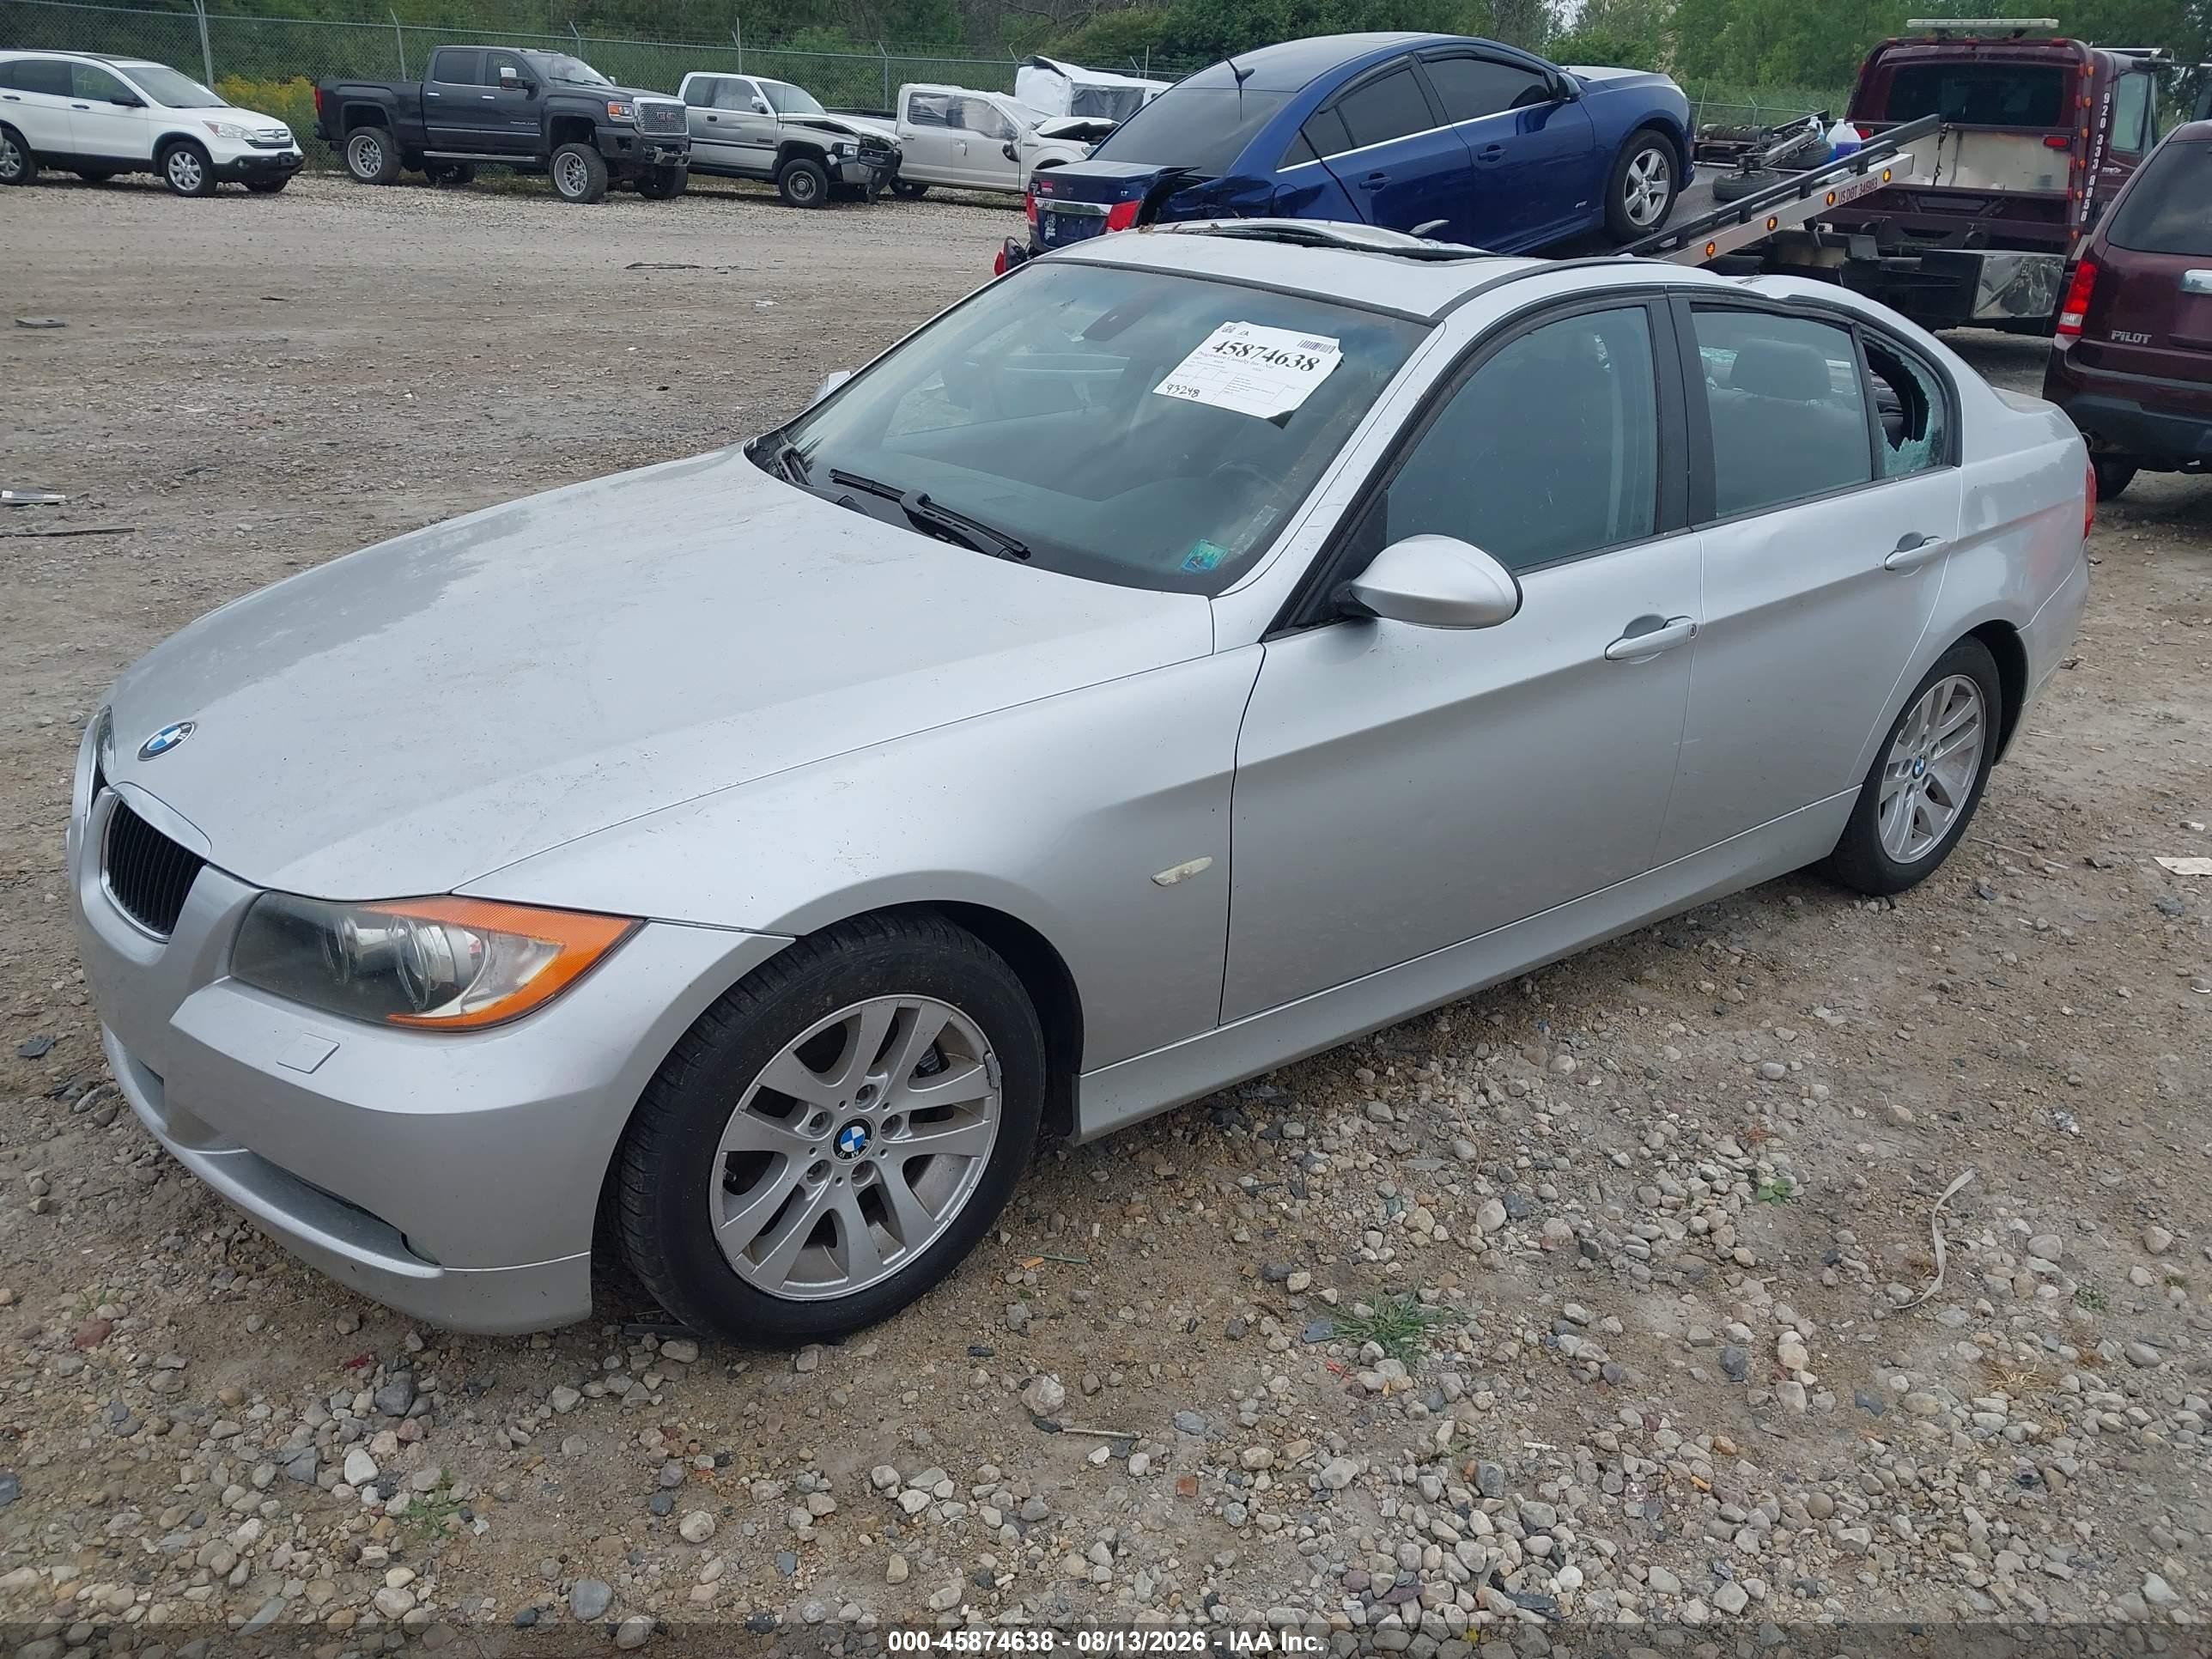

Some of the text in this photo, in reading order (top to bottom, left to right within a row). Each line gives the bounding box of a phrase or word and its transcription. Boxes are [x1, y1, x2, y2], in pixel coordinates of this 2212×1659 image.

[2100, 93, 2110, 128] 920
[2093, 134, 2104, 169] 333
[2111, 330, 2153, 343] PILOT
[1212, 340, 1321, 372] 45874638
